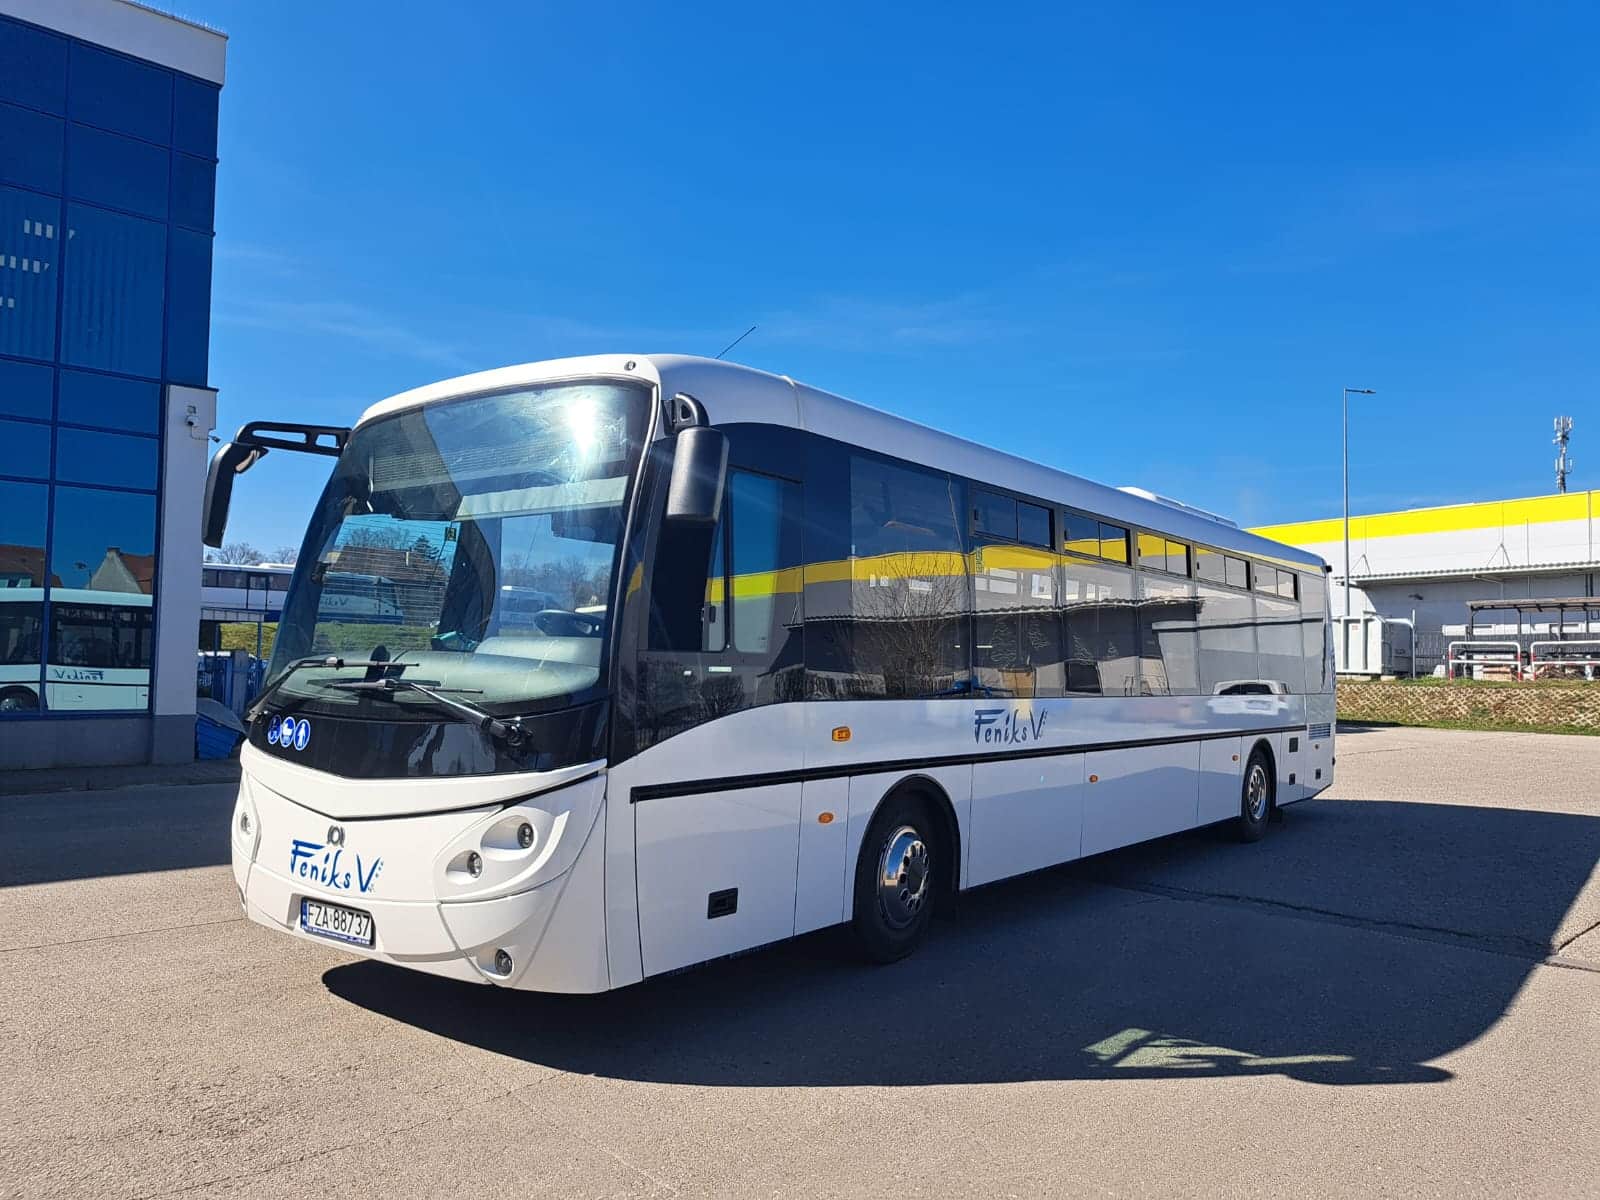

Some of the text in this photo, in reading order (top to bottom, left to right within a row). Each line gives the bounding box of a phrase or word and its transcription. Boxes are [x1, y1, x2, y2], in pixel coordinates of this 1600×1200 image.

[974, 707, 1047, 745] Feniks V
[290, 839, 381, 893] Feniks V
[308, 903, 329, 930] FZA
[333, 907, 370, 937] 88737
